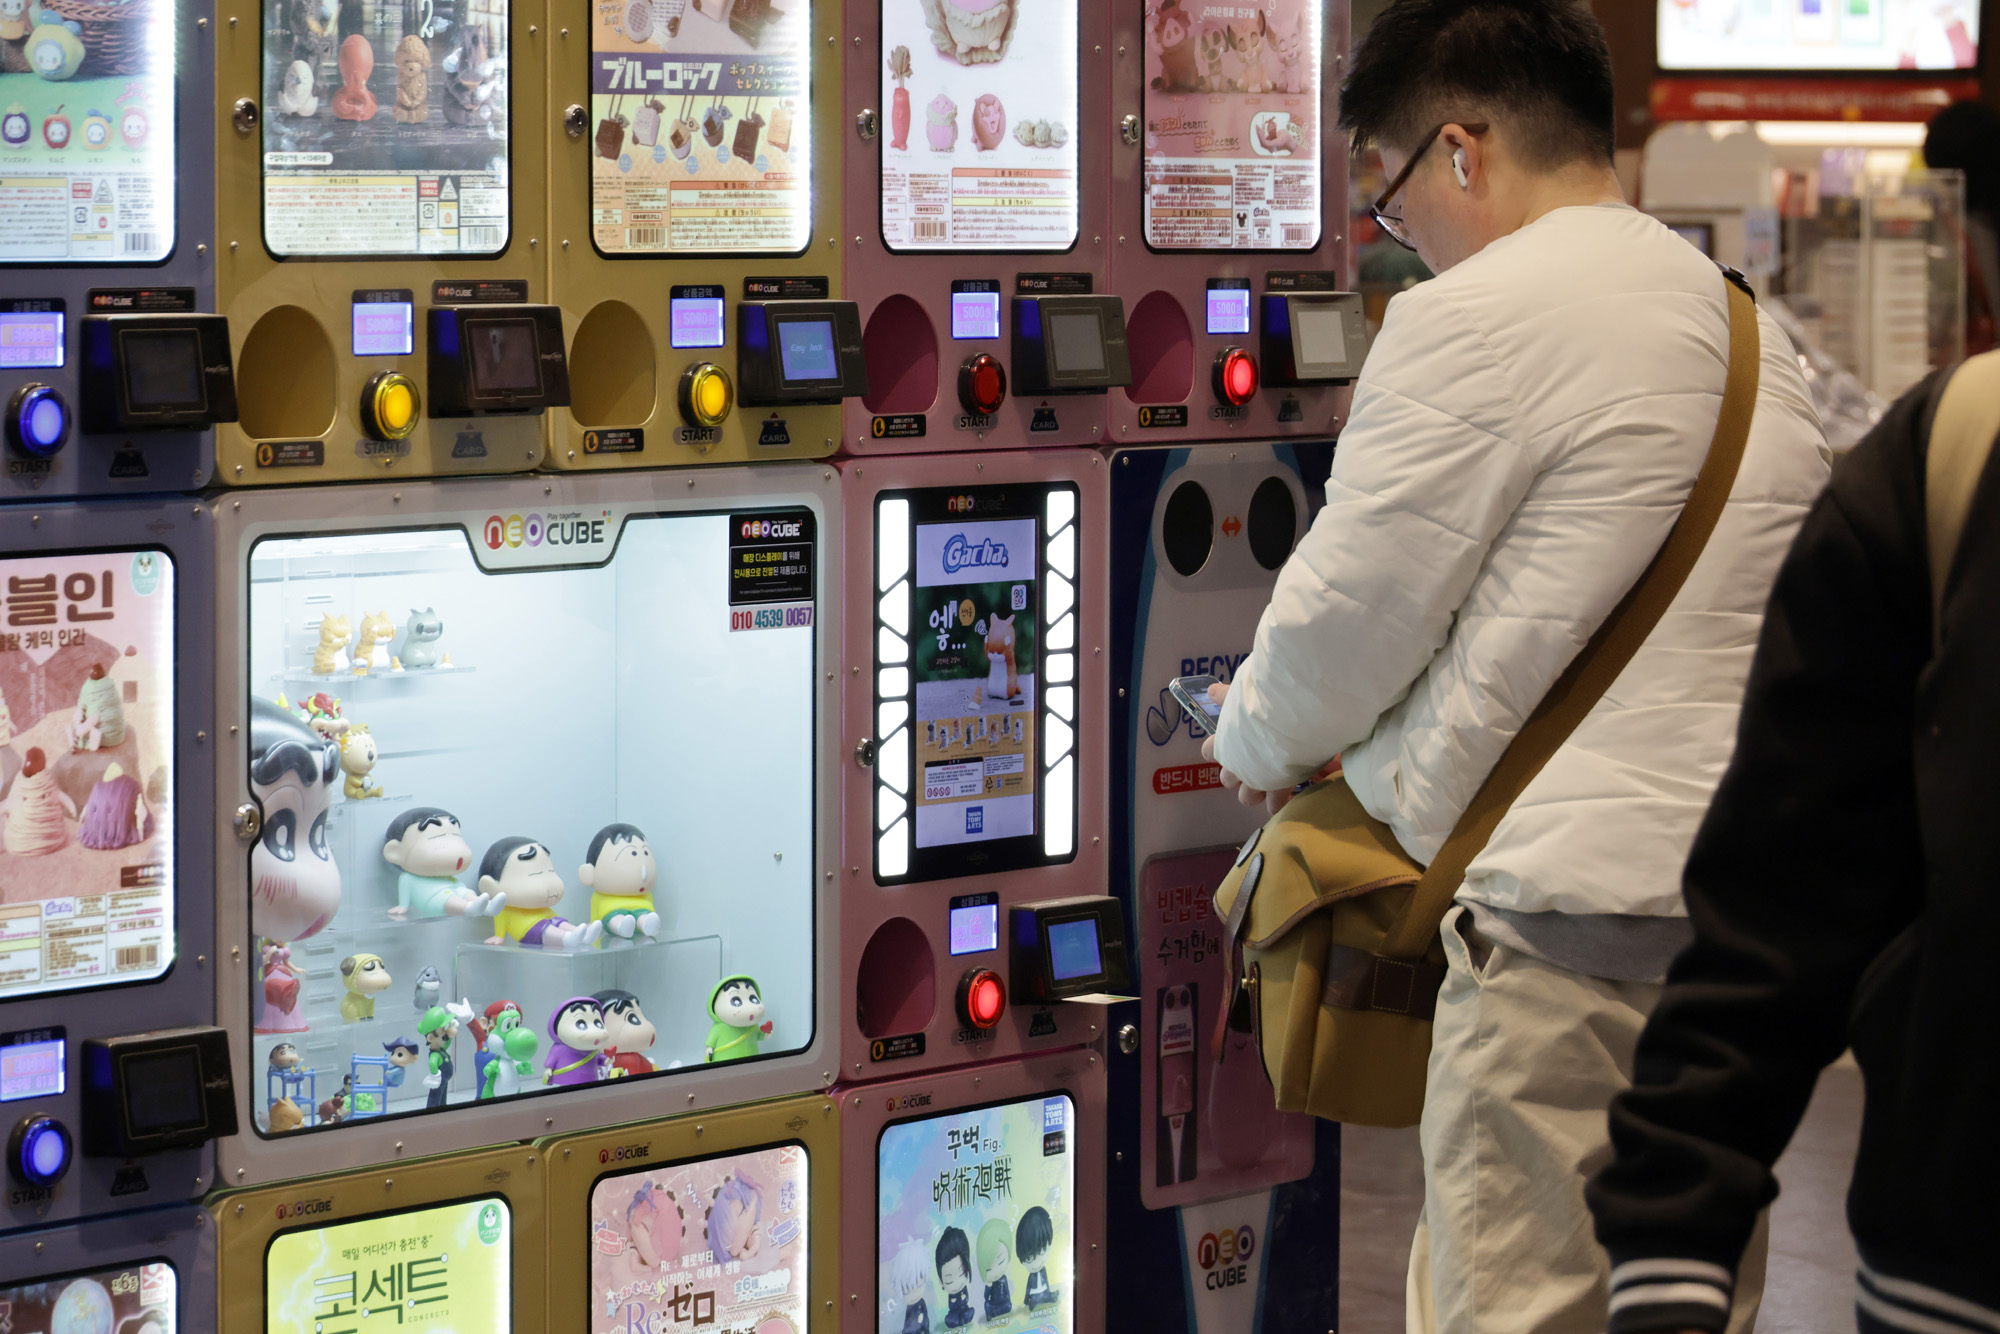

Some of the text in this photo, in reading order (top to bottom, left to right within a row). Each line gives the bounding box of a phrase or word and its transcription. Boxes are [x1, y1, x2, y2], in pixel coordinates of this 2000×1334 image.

[602, 57, 722, 91] ブルーロック
[1214, 406, 1242, 418] START
[960, 416, 990, 428] START
[1033, 421, 1056, 429] CARD
[681, 429, 714, 442] START
[761, 434, 787, 442] CARD
[365, 442, 401, 456] START
[456, 446, 483, 455] CARD
[10, 460, 52, 474] START
[547, 512, 582, 521] Play together
[546, 520, 605, 545] CUBE
[771, 523, 800, 537] CUBE
[0, 569, 115, 627] 블인
[732, 606, 813, 630] 010 4539 0057
[25, 630, 53, 649] 케익
[58, 627, 86, 648] 인간
[1181, 653, 1250, 683] RECY
[1160, 769, 1193, 790] 반드시
[967, 821, 982, 829] ARTS
[1157, 883, 1215, 925] 빈캡슐
[1156, 929, 1218, 966] 수거함에
[958, 1030, 988, 1043] START
[910, 1095, 931, 1108] CUBE
[1045, 1110, 1063, 1120] TOMY
[1045, 1117, 1063, 1128] ARTS
[947, 1124, 1002, 1160] 꾸벅 Fig.
[625, 1146, 649, 1159] CUBE
[933, 1157, 1012, 1213] 呪術廻戦
[12, 1187, 53, 1206] START
[304, 1200, 332, 1215] CUBE
[342, 1247, 360, 1261] 매일
[362, 1239, 396, 1257] 어디선가
[681, 1251, 714, 1268] 제로부터
[661, 1271, 693, 1287] 시작하는
[724, 1261, 741, 1276] 생활
[1205, 1265, 1247, 1291] CUBE
